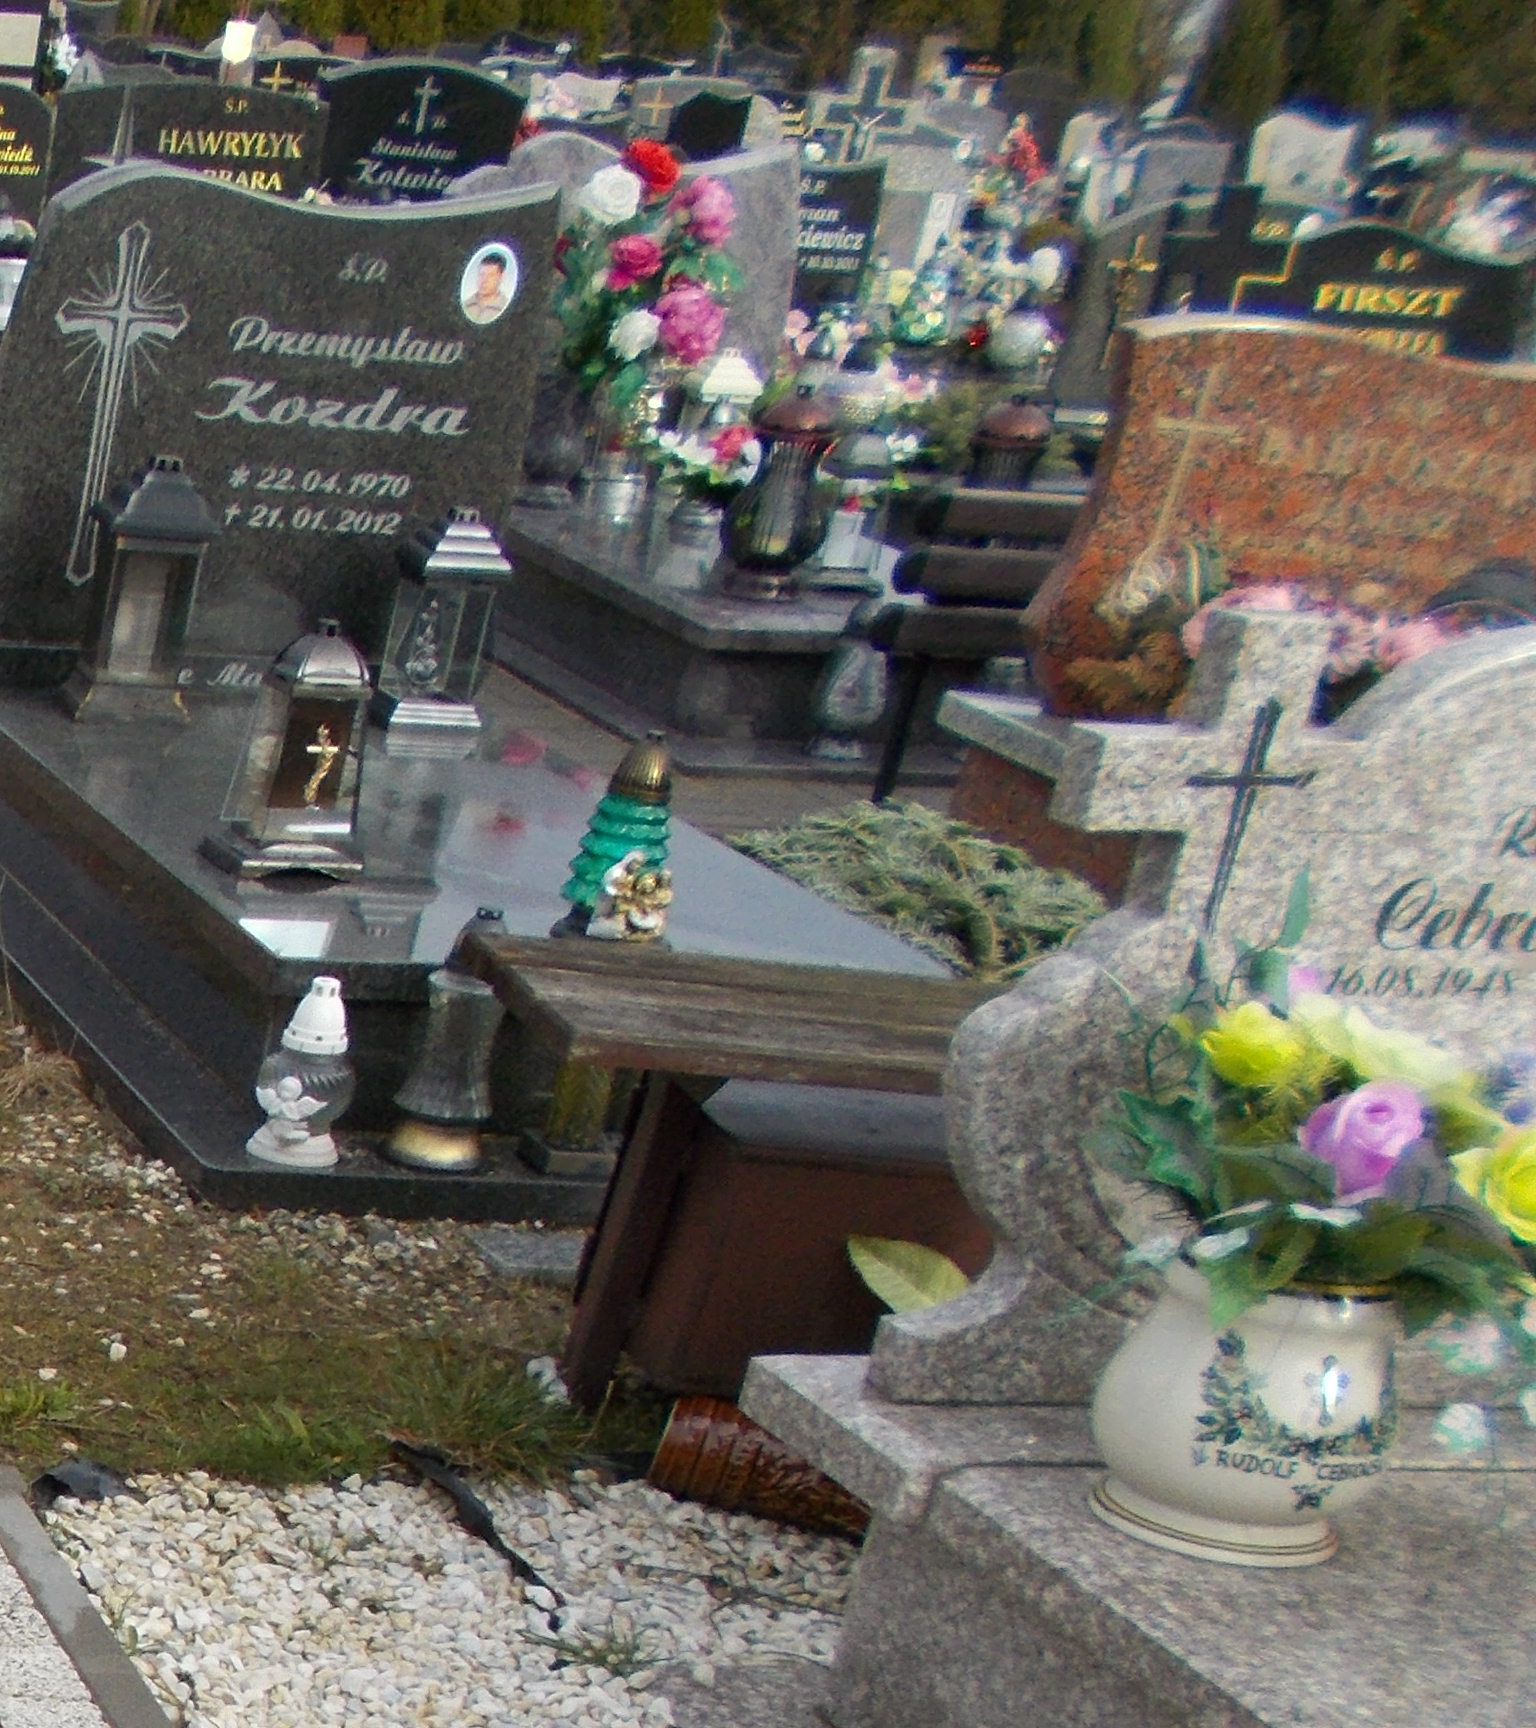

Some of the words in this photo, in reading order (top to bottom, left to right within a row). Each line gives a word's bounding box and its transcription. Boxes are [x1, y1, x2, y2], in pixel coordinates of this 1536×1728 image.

[158, 128, 304, 159] HAWRYŁYK
[1313, 281, 1465, 317] FIRSZT
[229, 316, 464, 368] Przemysław
[194, 375, 470, 436] Kozdra
